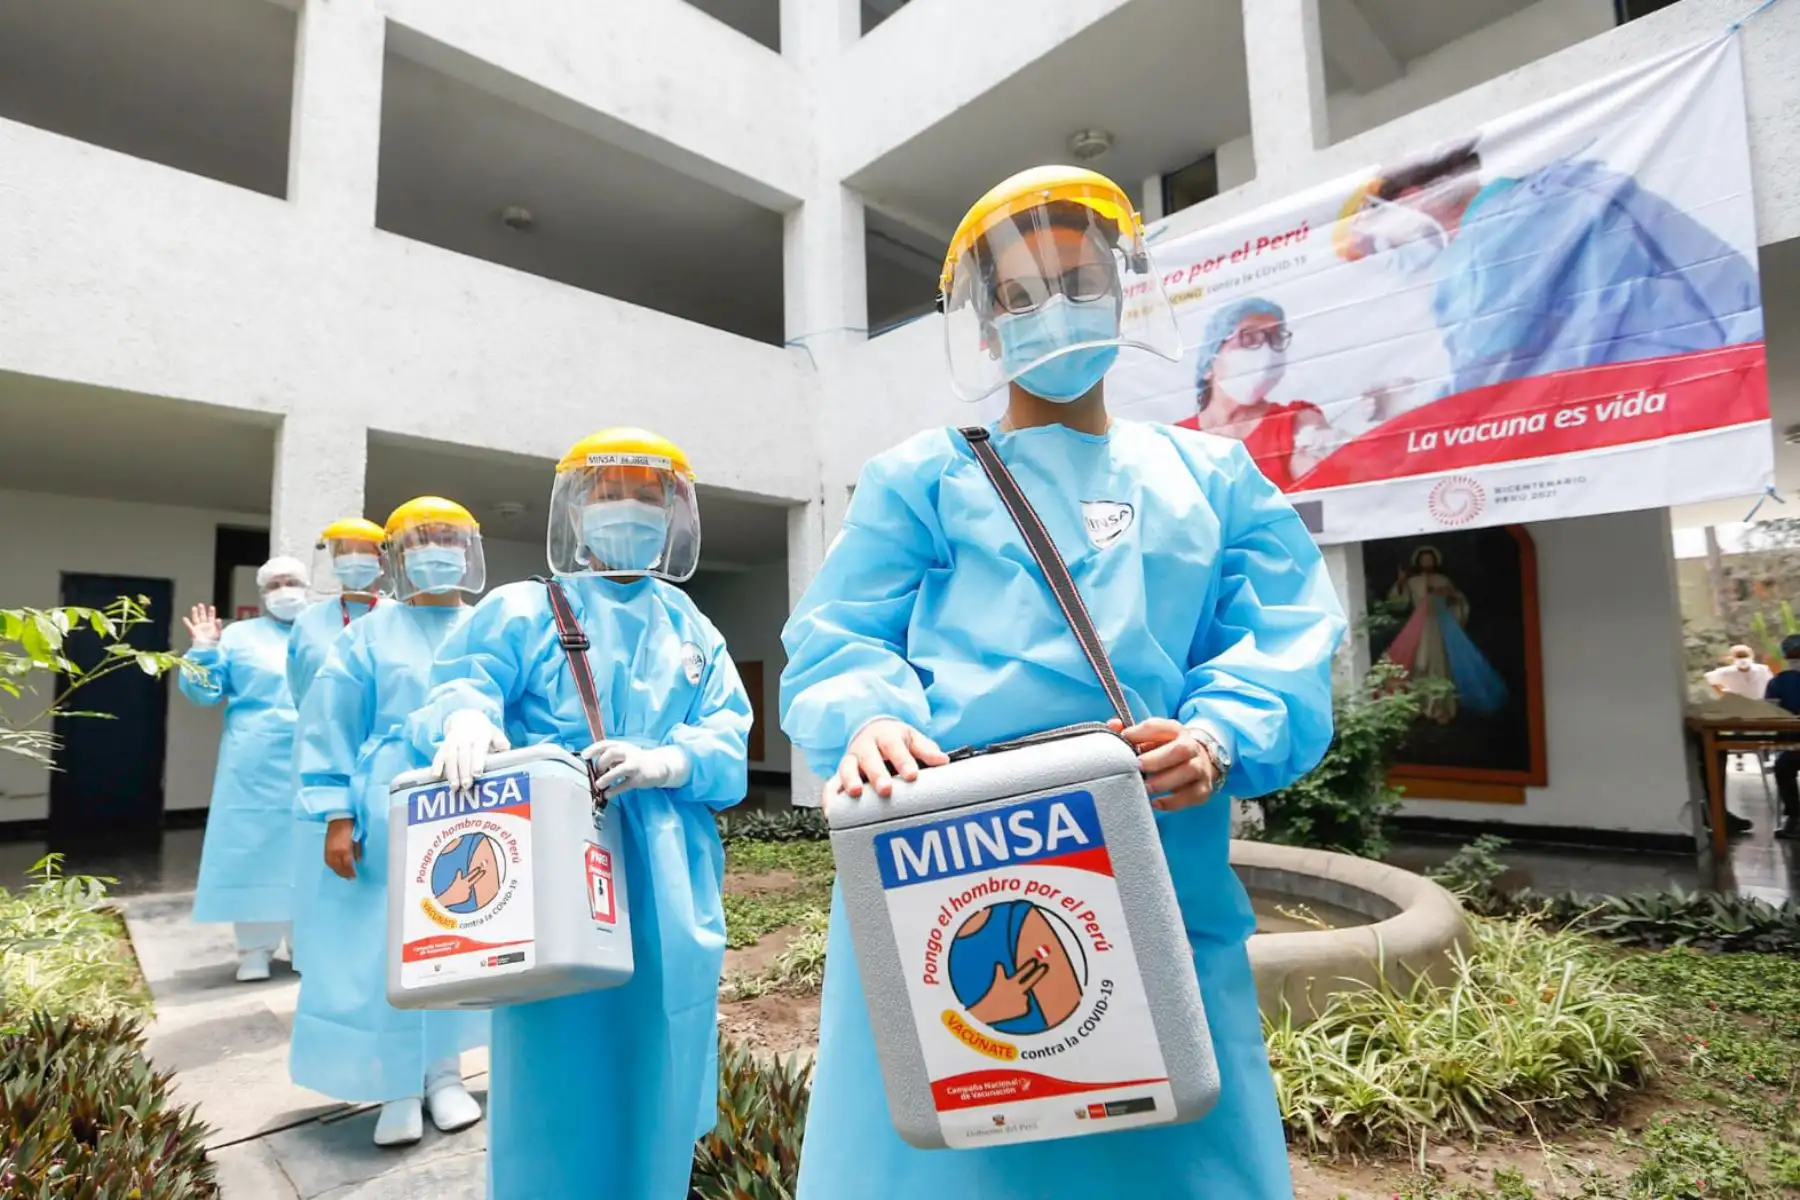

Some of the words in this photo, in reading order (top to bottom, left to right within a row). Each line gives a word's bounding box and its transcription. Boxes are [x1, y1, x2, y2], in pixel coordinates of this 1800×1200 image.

[1187, 255, 1226, 284] por
[1229, 239, 1250, 264] el
[1255, 219, 1310, 257] Perú
[1407, 431, 1437, 453] La
[1443, 412, 1548, 447] vacuna
[1554, 406, 1588, 429] es
[1594, 390, 1668, 422] vida
[1494, 476, 1587, 494] BICENTENARIO
[416, 777, 523, 821] MINSA
[416, 848, 434, 884] Pongo
[433, 834, 443, 848] el
[441, 817, 482, 840] hombro
[482, 820, 502, 833] por
[500, 829, 512, 840] el
[507, 839, 523, 865] Perú
[889, 802, 1090, 881] MINSA
[459, 918, 485, 929] contra
[484, 913, 493, 922] la
[923, 927, 943, 986] Pongo
[939, 906, 953, 928] el
[948, 876, 1021, 913] hombro
[1024, 879, 1062, 900] por
[1060, 894, 1085, 913] el
[1076, 908, 1114, 953] Perú
[1020, 1042, 1066, 1061] contra
[1065, 1034, 1080, 1049] la
[1077, 979, 1114, 1039] COVID-19
[946, 1083, 983, 1095] Campaña
[960, 1092, 971, 1101] de
